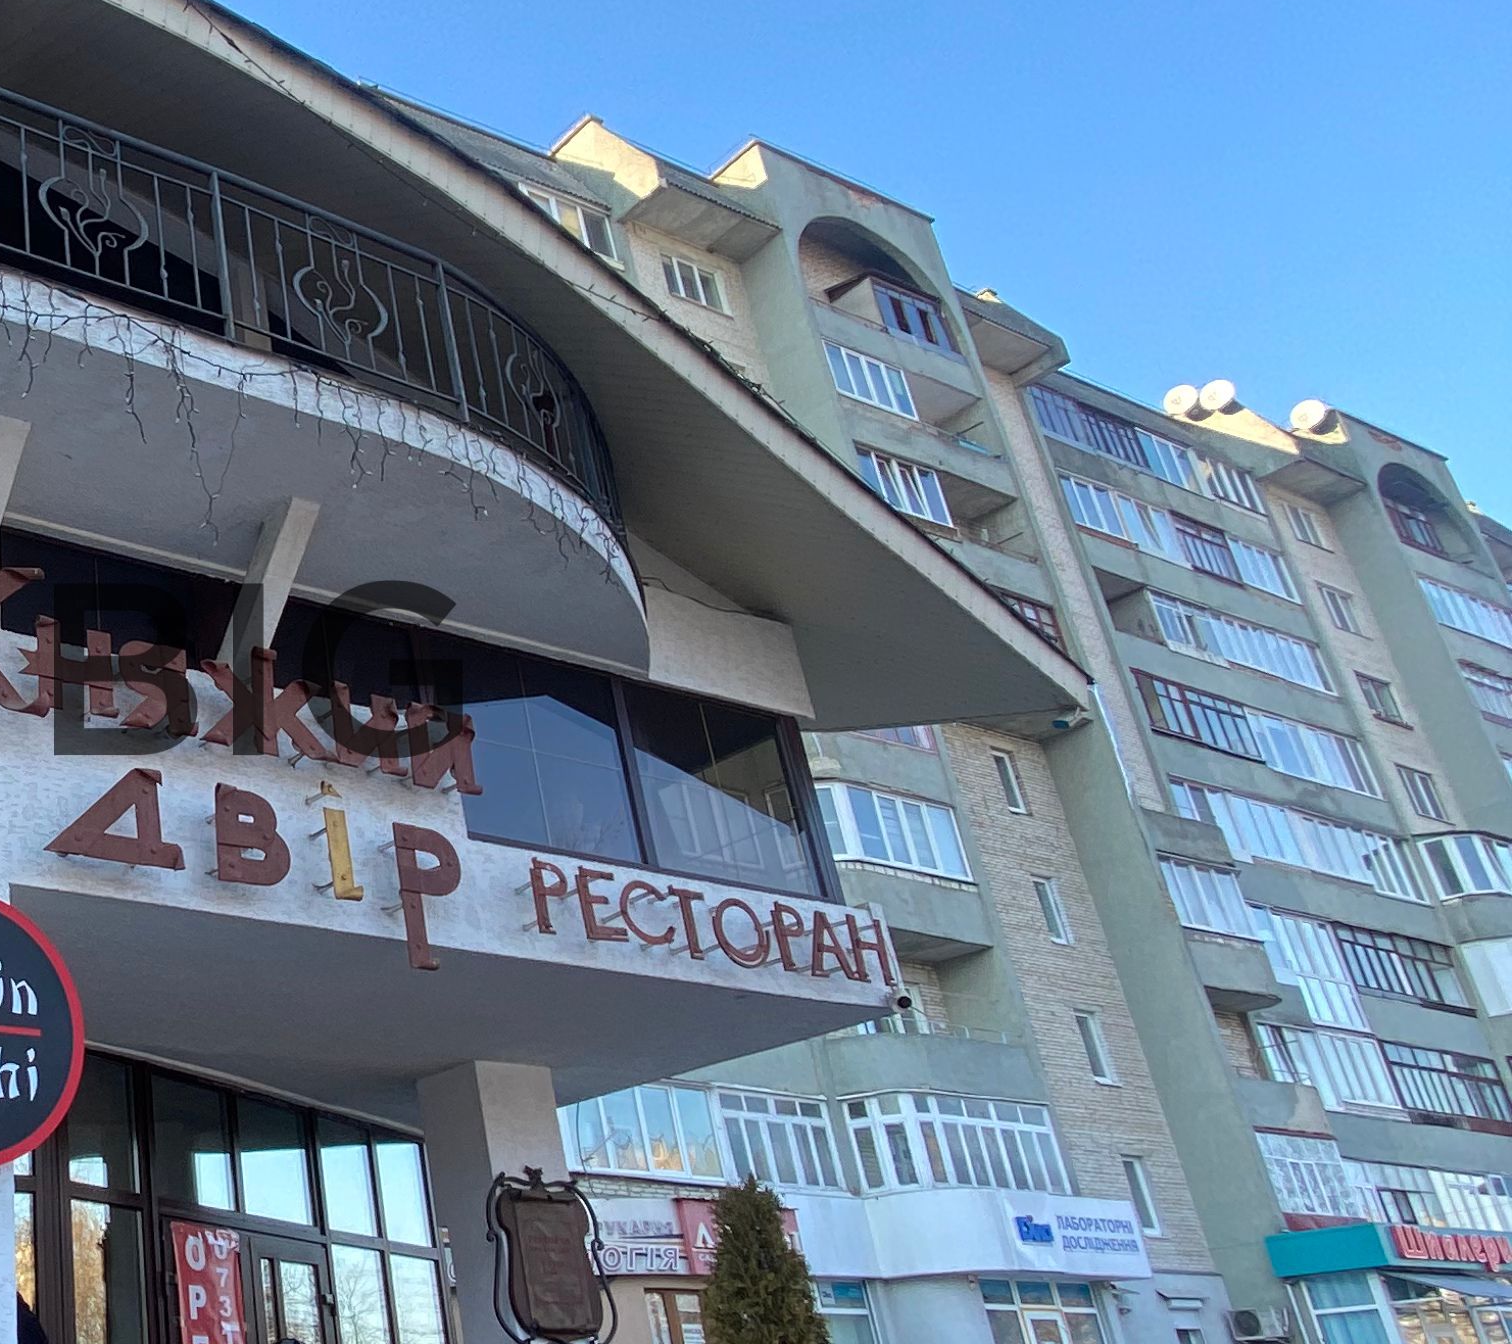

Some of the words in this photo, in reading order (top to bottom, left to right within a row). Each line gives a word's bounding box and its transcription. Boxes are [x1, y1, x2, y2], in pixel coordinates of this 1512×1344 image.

[530, 857, 896, 985] РЕСТОРАН
[1056, 1215, 1134, 1234] ЛАБОРАТОРНІ
[1062, 1235, 1140, 1253] ДОСЛІДЖЕННЯ
